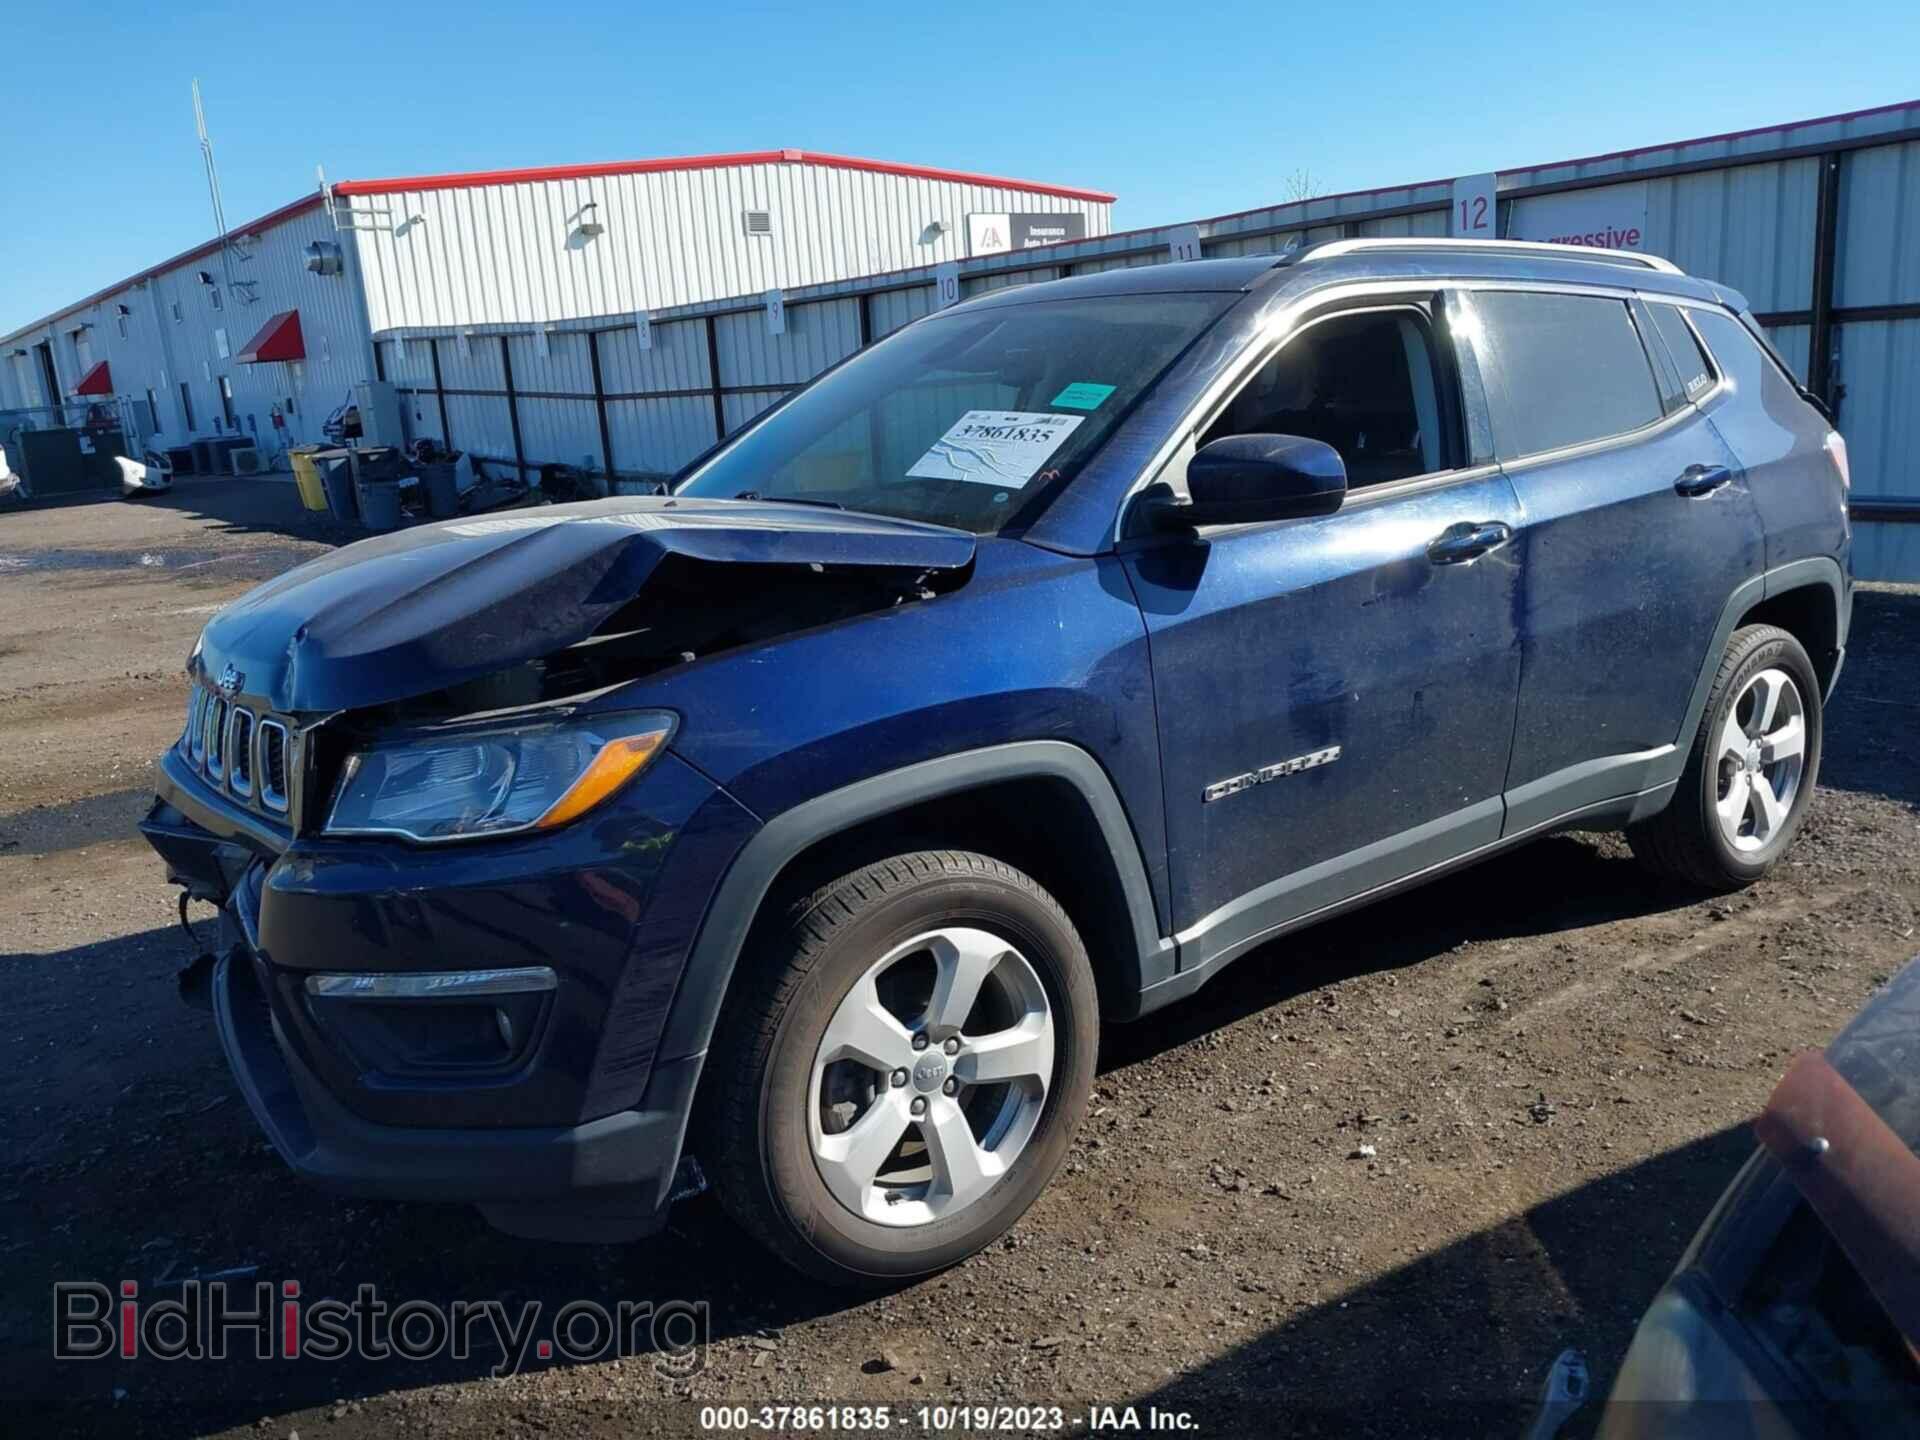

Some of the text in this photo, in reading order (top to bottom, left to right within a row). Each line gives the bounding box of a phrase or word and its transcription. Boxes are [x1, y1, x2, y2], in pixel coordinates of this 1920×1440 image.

[1460, 196, 1488, 231] 12
[940, 278, 955, 301] 10
[771, 301, 779, 321] 9
[956, 423, 1056, 443] 37861835
